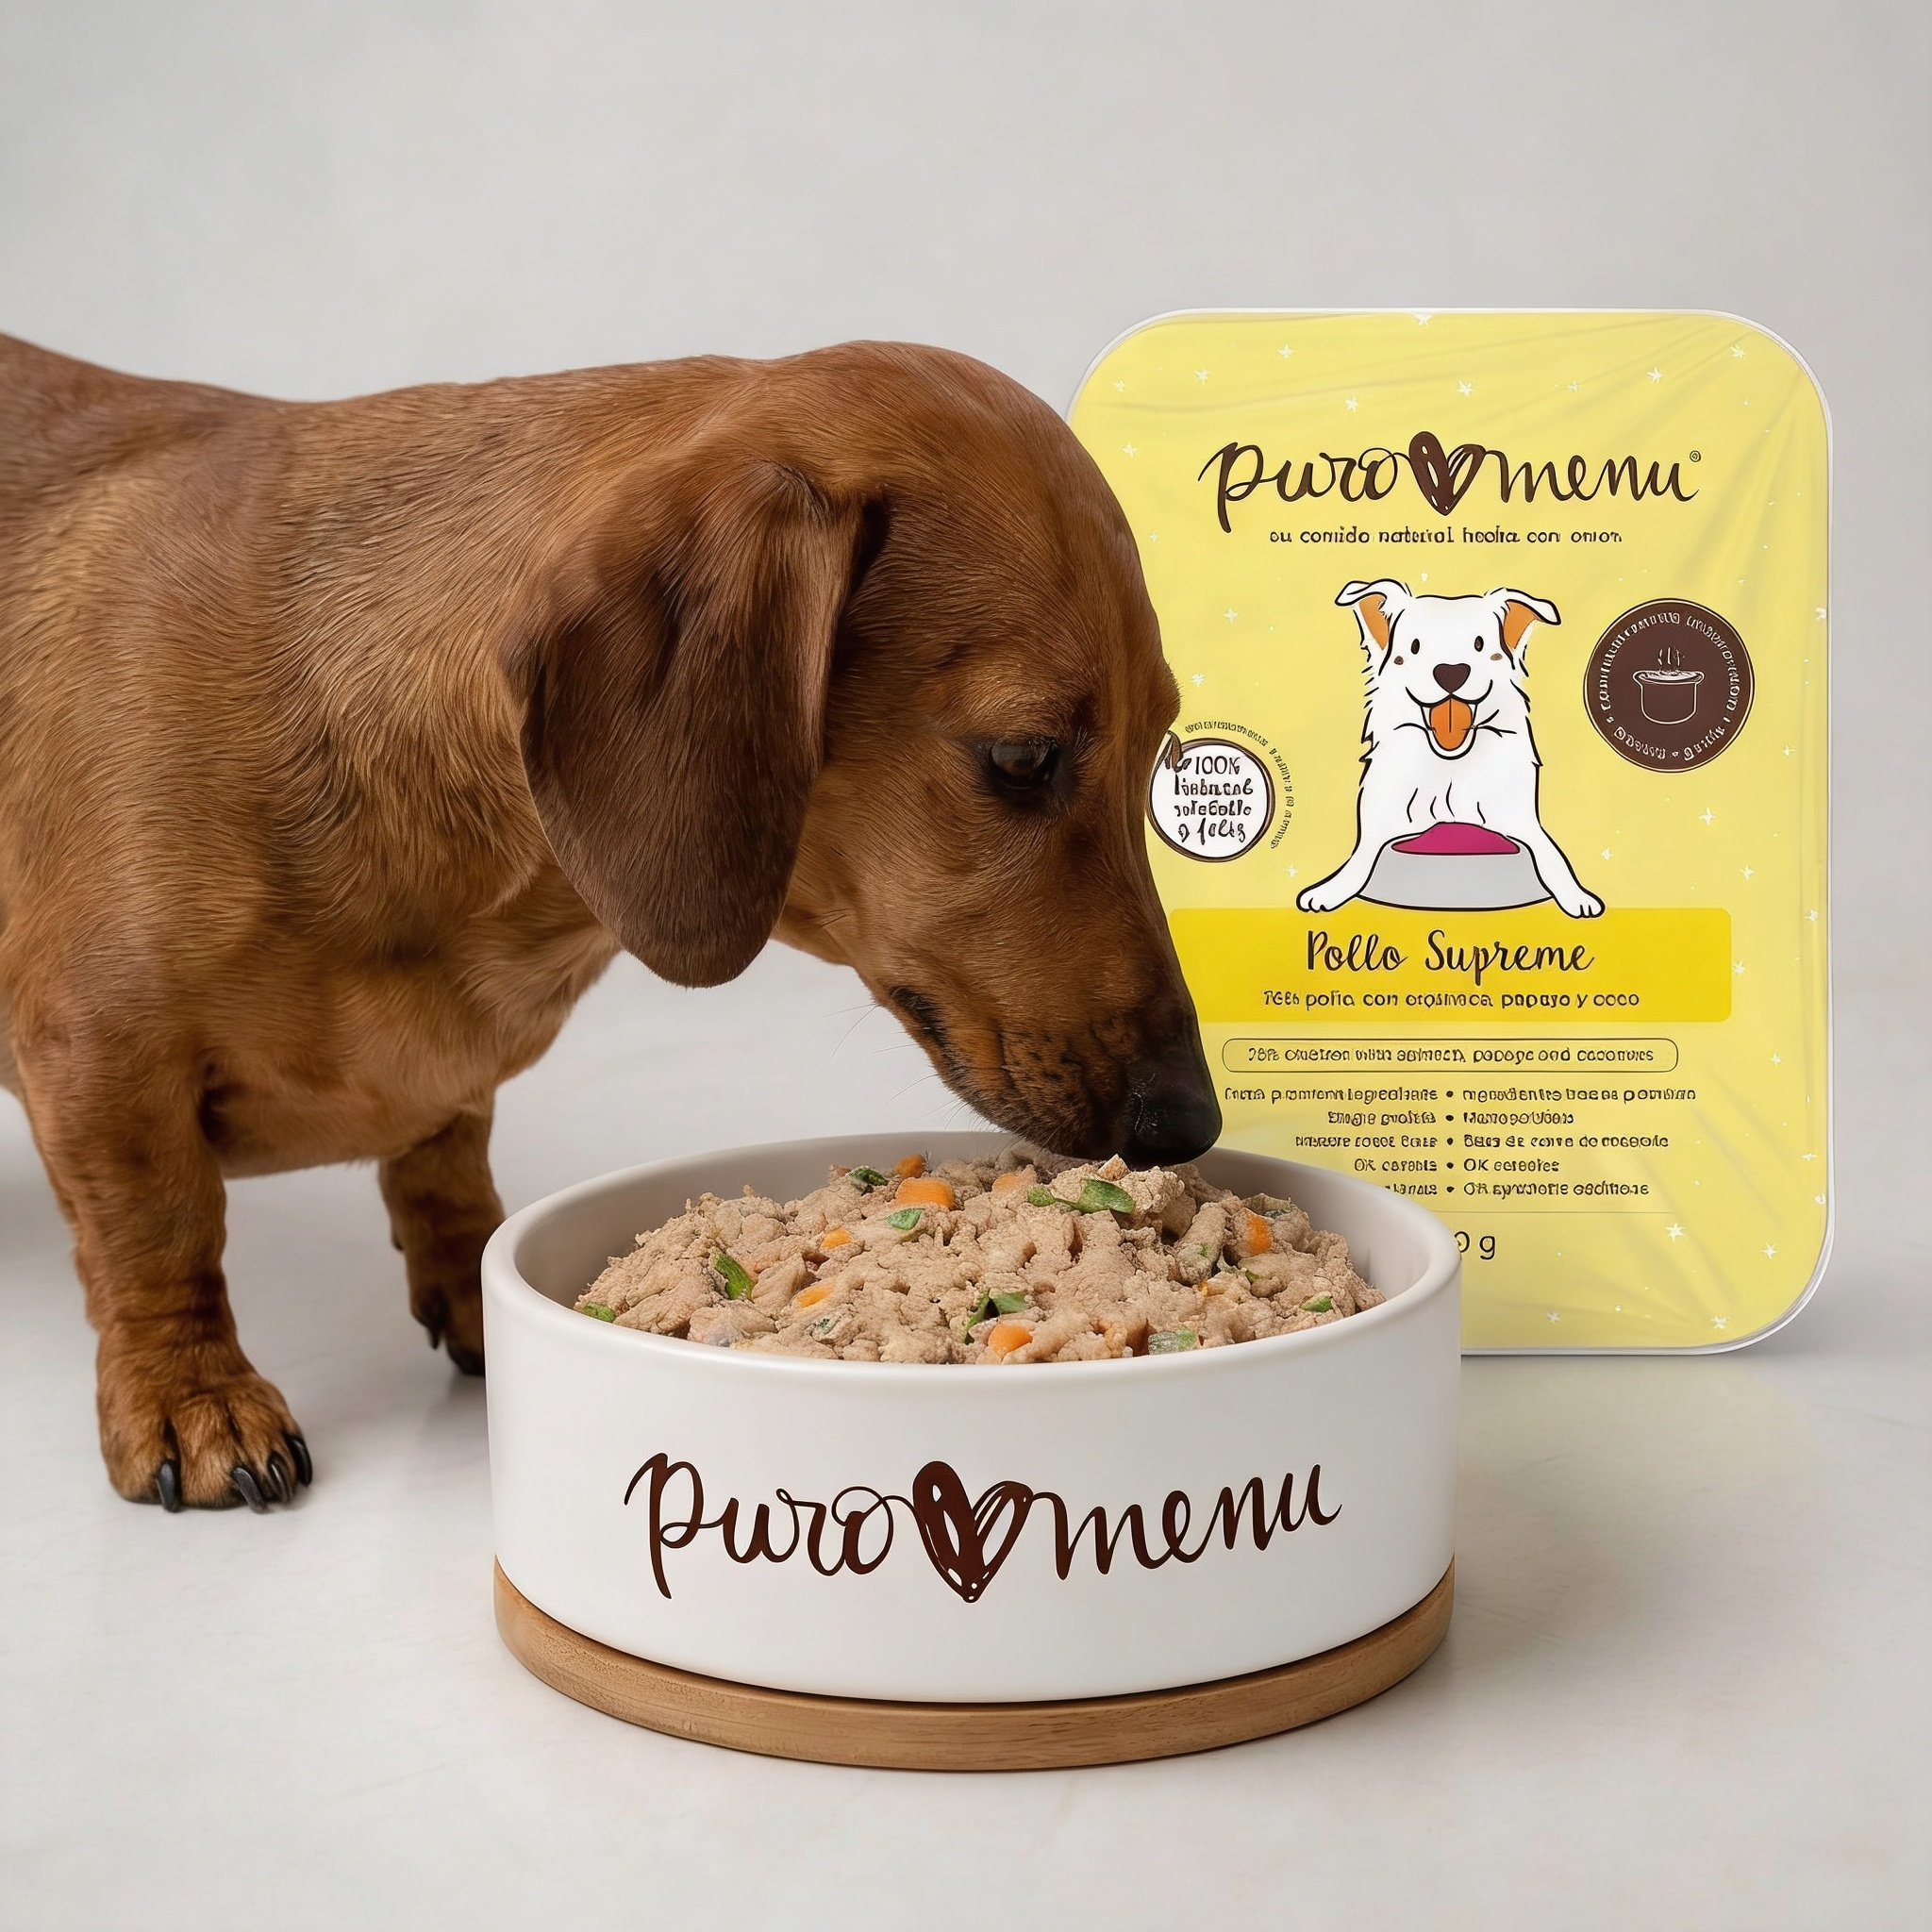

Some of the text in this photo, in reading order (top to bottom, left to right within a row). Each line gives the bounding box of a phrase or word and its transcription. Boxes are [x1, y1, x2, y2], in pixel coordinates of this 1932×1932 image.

[1198, 441, 1700, 533] puro menu
[1526, 531, 1561, 543] con
[1307, 928, 1595, 987] Pollo Supreme
[1362, 993, 1399, 1007] con
[1575, 993, 1589, 1008] y
[1479, 1235, 1496, 1260] g
[624, 1452, 1343, 1600] puro menu
